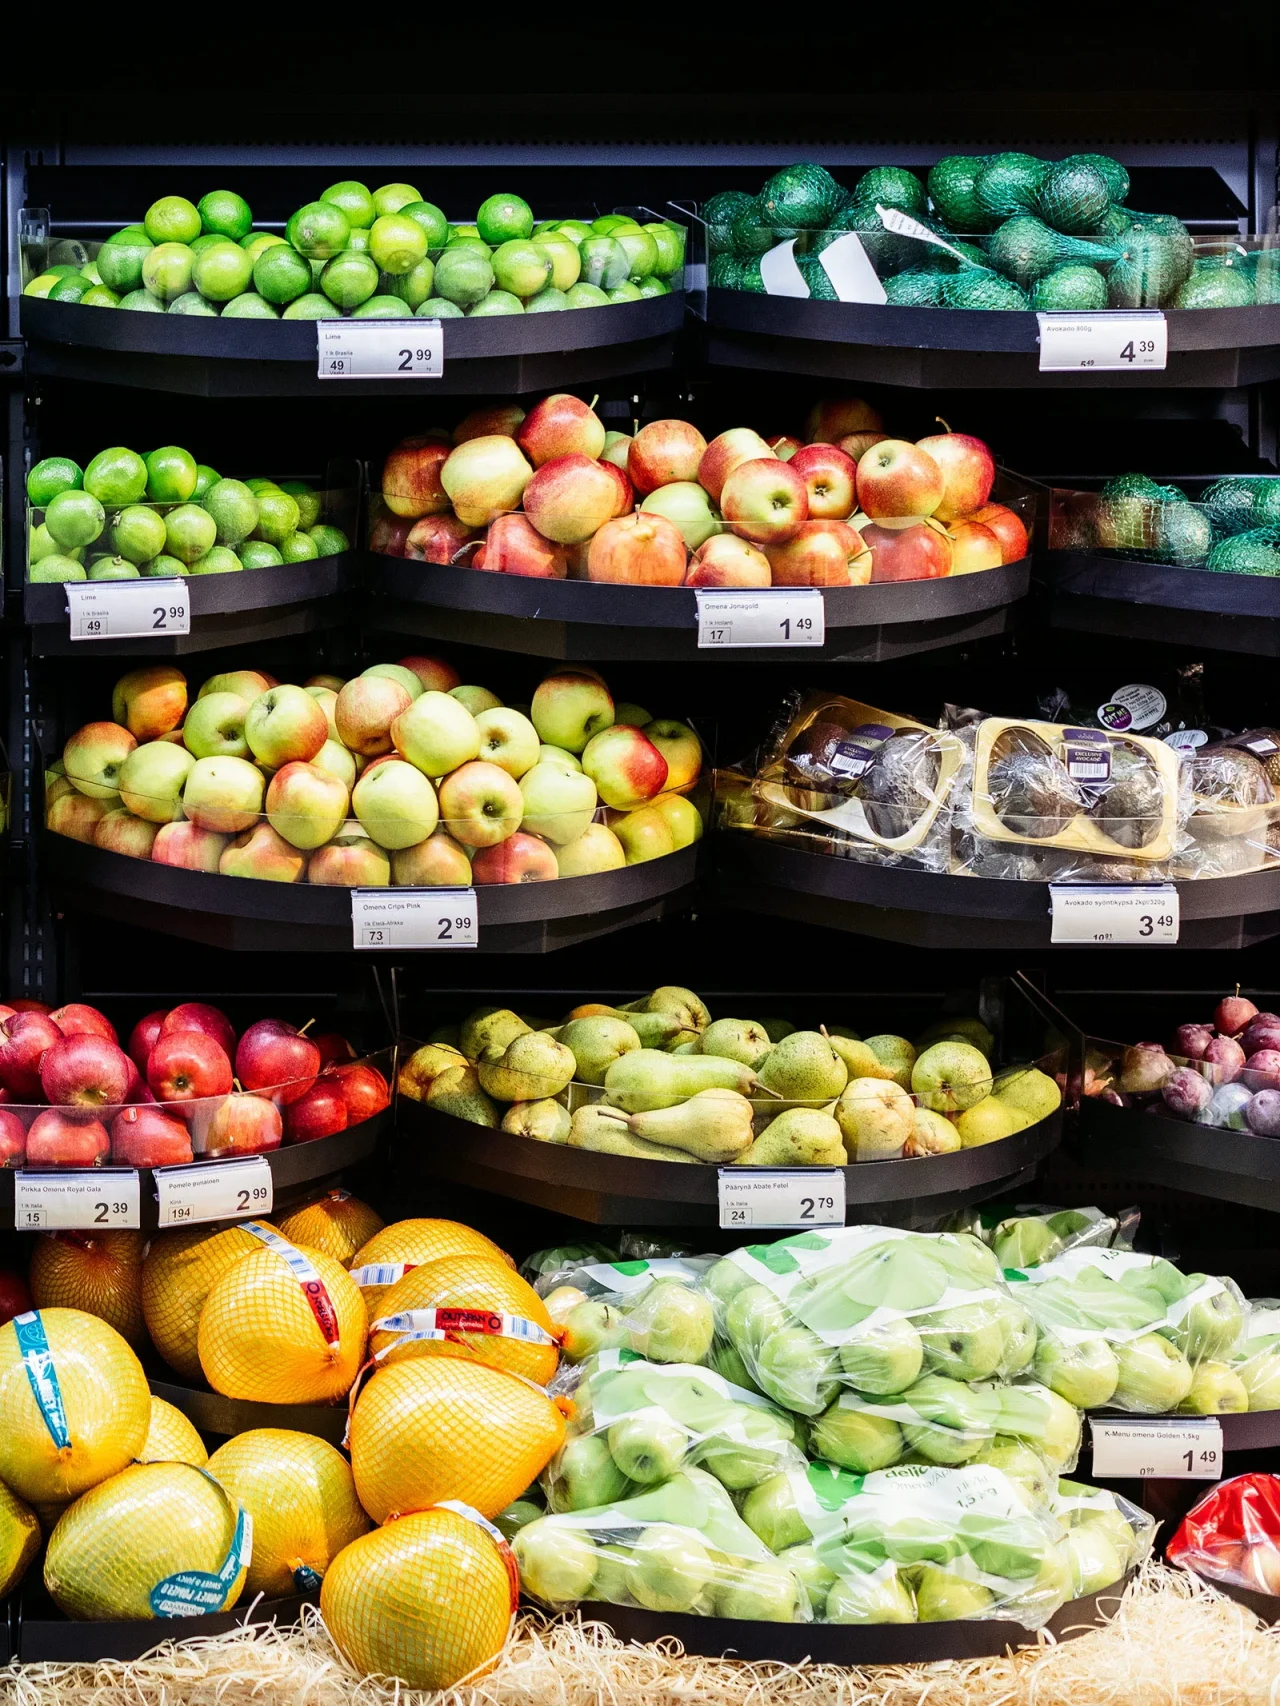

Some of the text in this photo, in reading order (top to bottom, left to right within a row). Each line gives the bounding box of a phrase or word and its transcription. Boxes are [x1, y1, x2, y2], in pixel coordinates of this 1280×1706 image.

[1120, 341, 1154, 363] 4 39
[330, 360, 344, 370] 49
[398, 349, 432, 371] 2 99
[152, 607, 184, 628] 2 99
[87, 621, 100, 630] 49
[780, 619, 812, 640] 1 49
[710, 630, 723, 640] 17
[1104, 712, 1118, 724] EAT
[388, 903, 405, 911] Crips
[437, 918, 470, 940] 2 99
[1139, 915, 1173, 936] 3 49
[369, 931, 383, 941] 73
[193, 1178, 219, 1187] punainen
[237, 1188, 267, 1211] 2 99
[94, 1203, 127, 1222] 2 39
[172, 1208, 190, 1219] 194
[731, 1211, 744, 1220] 24
[800, 1198, 833, 1219] 2 79
[27, 1213, 39, 1222] 15
[442, 1312, 486, 1322] OUTSPAN
[1183, 1450, 1216, 1471] 1 49
[160, 1583, 223, 1604] HONEY POMELO
